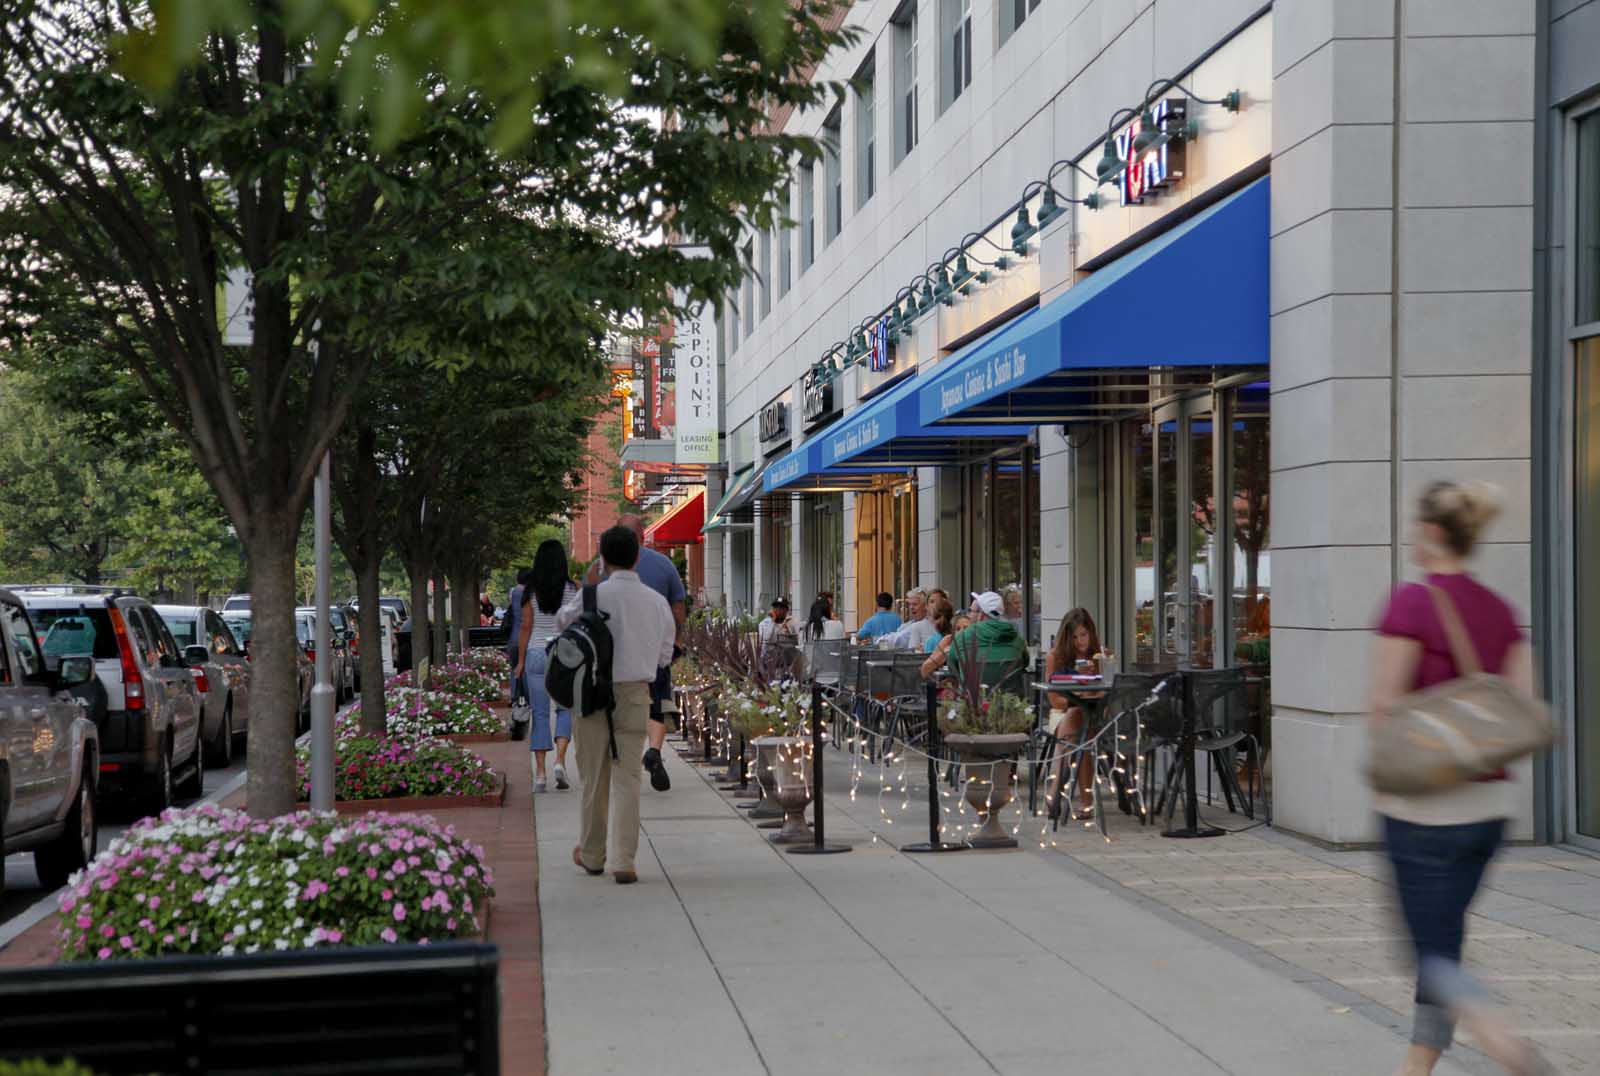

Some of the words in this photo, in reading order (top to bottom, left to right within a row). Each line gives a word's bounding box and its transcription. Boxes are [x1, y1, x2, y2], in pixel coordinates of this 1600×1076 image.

[689, 301, 703, 418] ORPOINT
[941, 384, 963, 416] Japanese
[964, 369, 985, 400] Cuisine
[994, 352, 1012, 388] Sushi
[1013, 347, 1027, 379] Bar
[680, 434, 713, 444] LEASING
[684, 445, 709, 453] OFFICE
